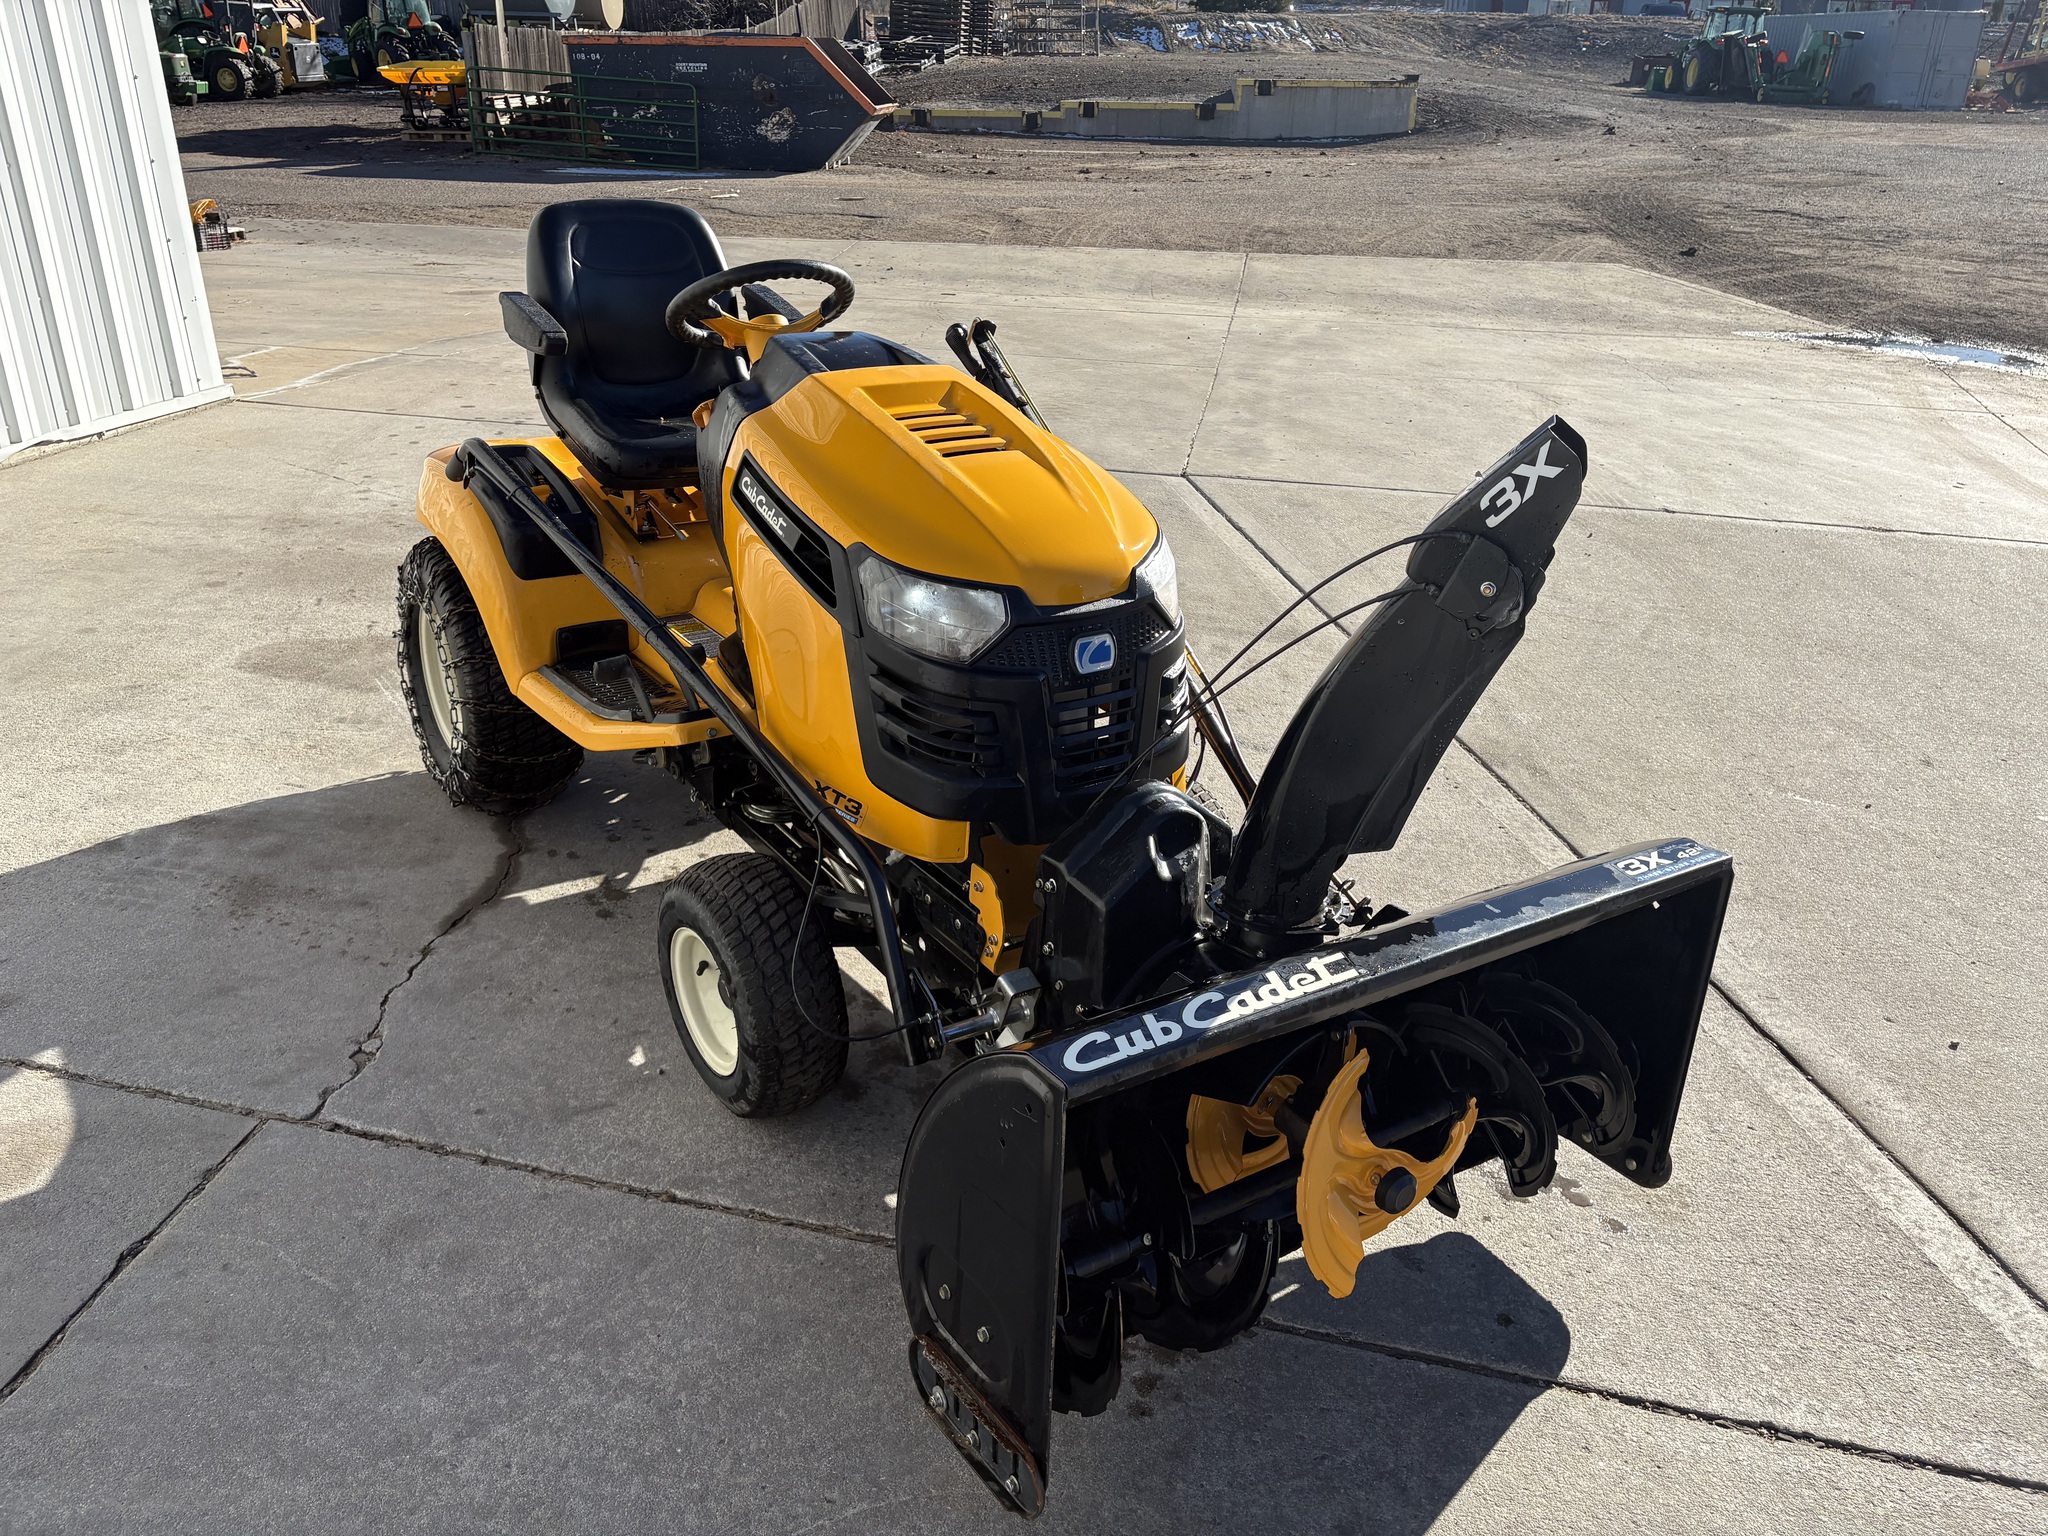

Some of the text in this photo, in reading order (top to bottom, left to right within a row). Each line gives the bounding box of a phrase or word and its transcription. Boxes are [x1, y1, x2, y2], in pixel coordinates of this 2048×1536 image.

[741, 476, 787, 535] Cub Cadet
[1479, 439, 1564, 528] 3X
[815, 779, 862, 815] XT3
[1617, 851, 1673, 875] 3X
[1062, 952, 1361, 1072] Cub Cadet
